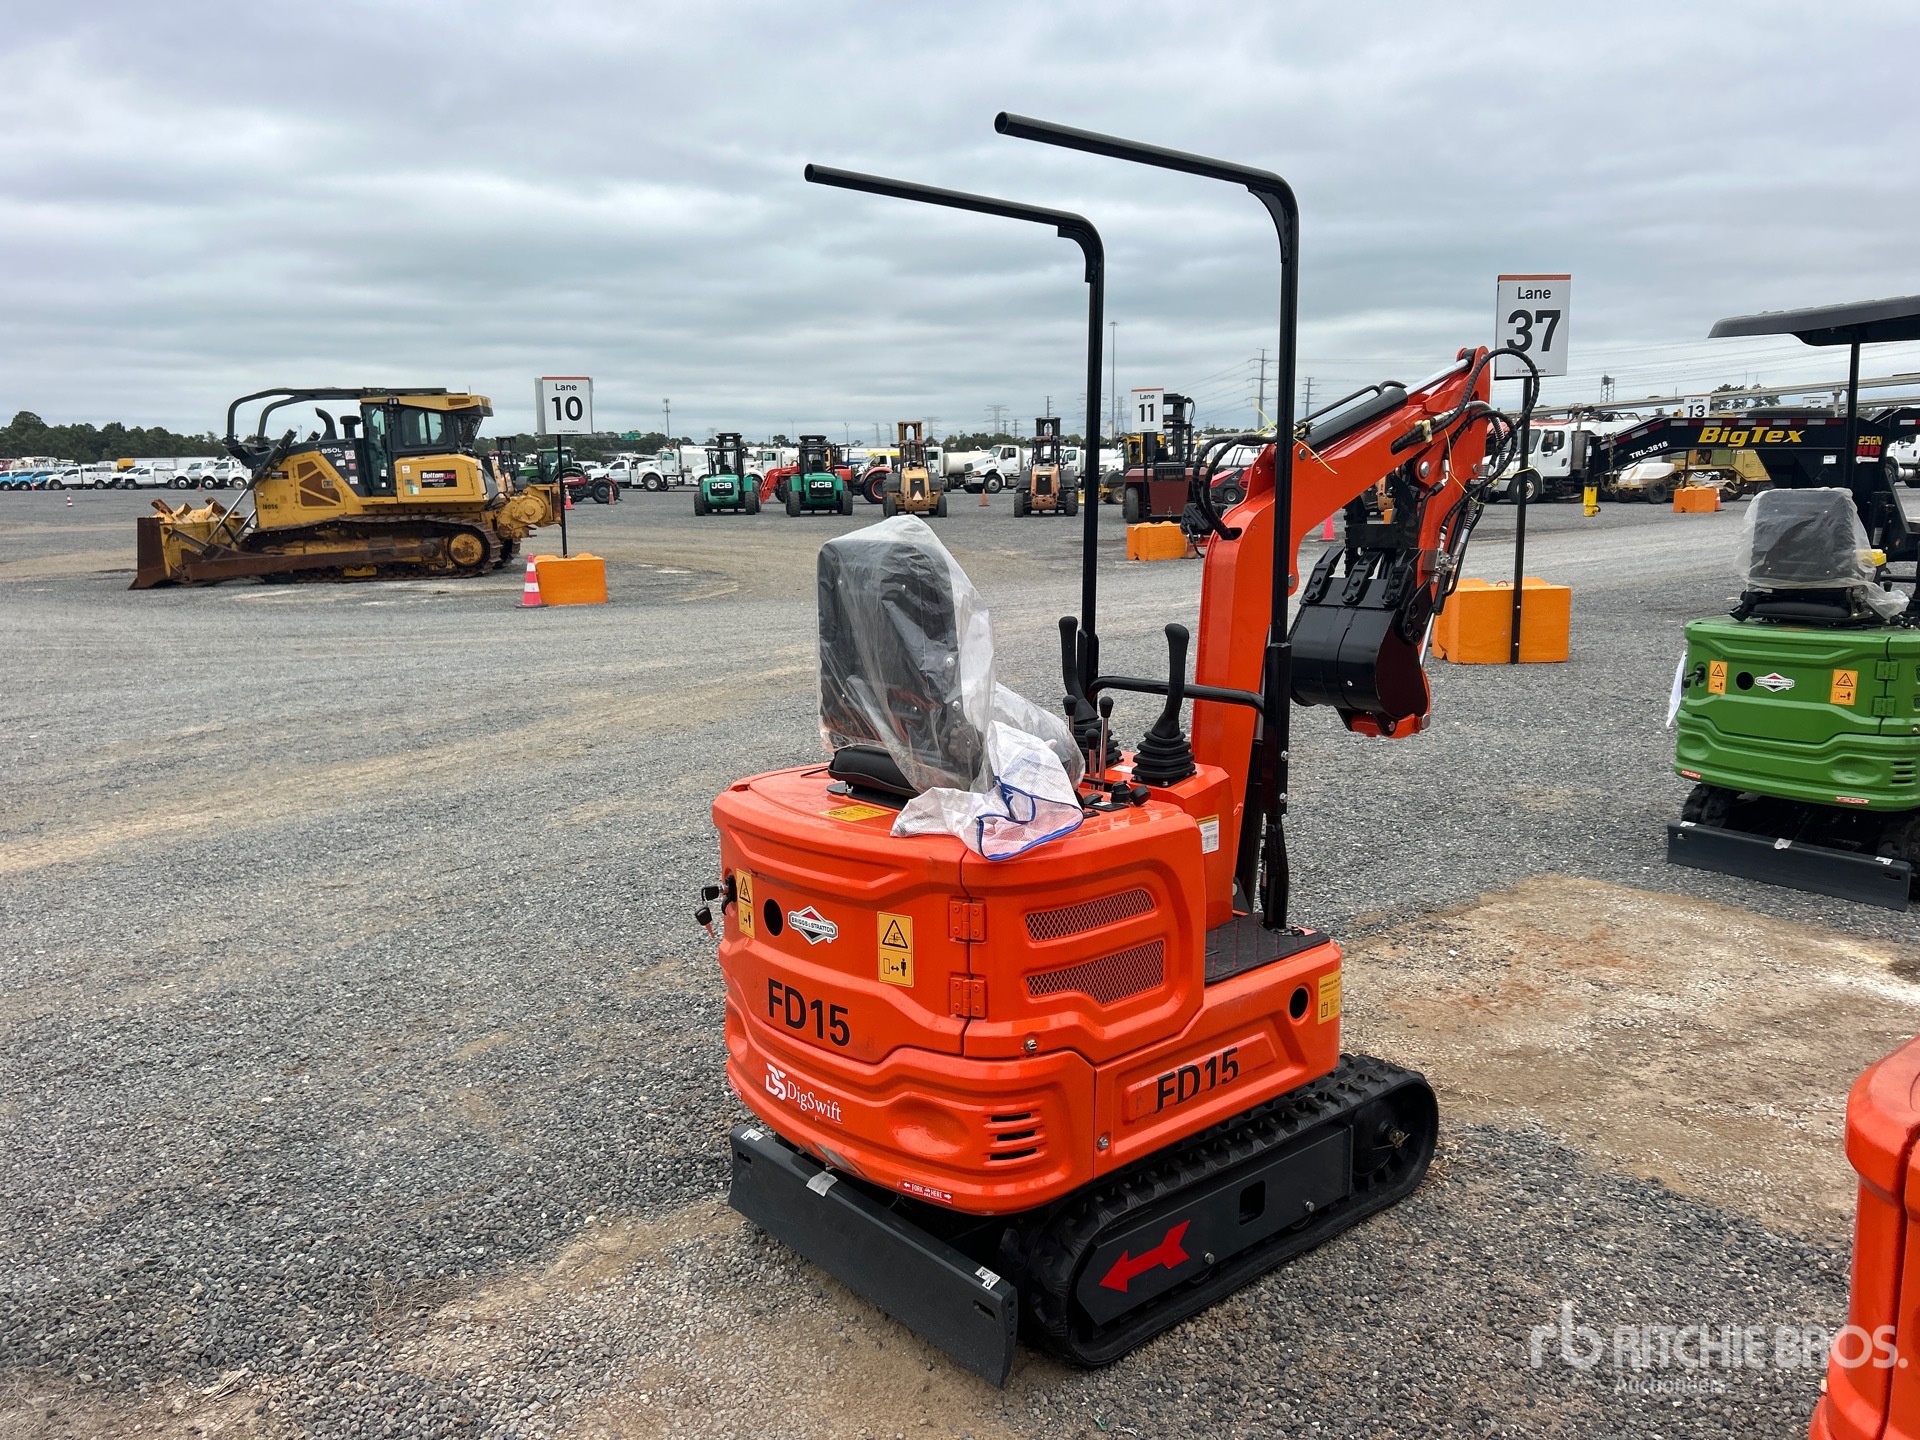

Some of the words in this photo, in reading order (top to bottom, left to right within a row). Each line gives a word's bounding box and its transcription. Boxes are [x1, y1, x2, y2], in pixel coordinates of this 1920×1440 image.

[1517, 286, 1551, 299] Lane
[1506, 309, 1561, 353] 37
[555, 383, 577, 391] Lane
[551, 396, 583, 421] 10
[1138, 403, 1154, 422] 11
[1687, 404, 1706, 418] 13
[1629, 440, 1669, 459] TRL-3818
[1856, 446, 1881, 456] HD
[768, 977, 850, 1047] FD15
[1155, 1047, 1239, 1115] FD15
[787, 1080, 842, 1122] DigSwift
[911, 1183, 924, 1194] FORK
[930, 1189, 943, 1199] HERE
